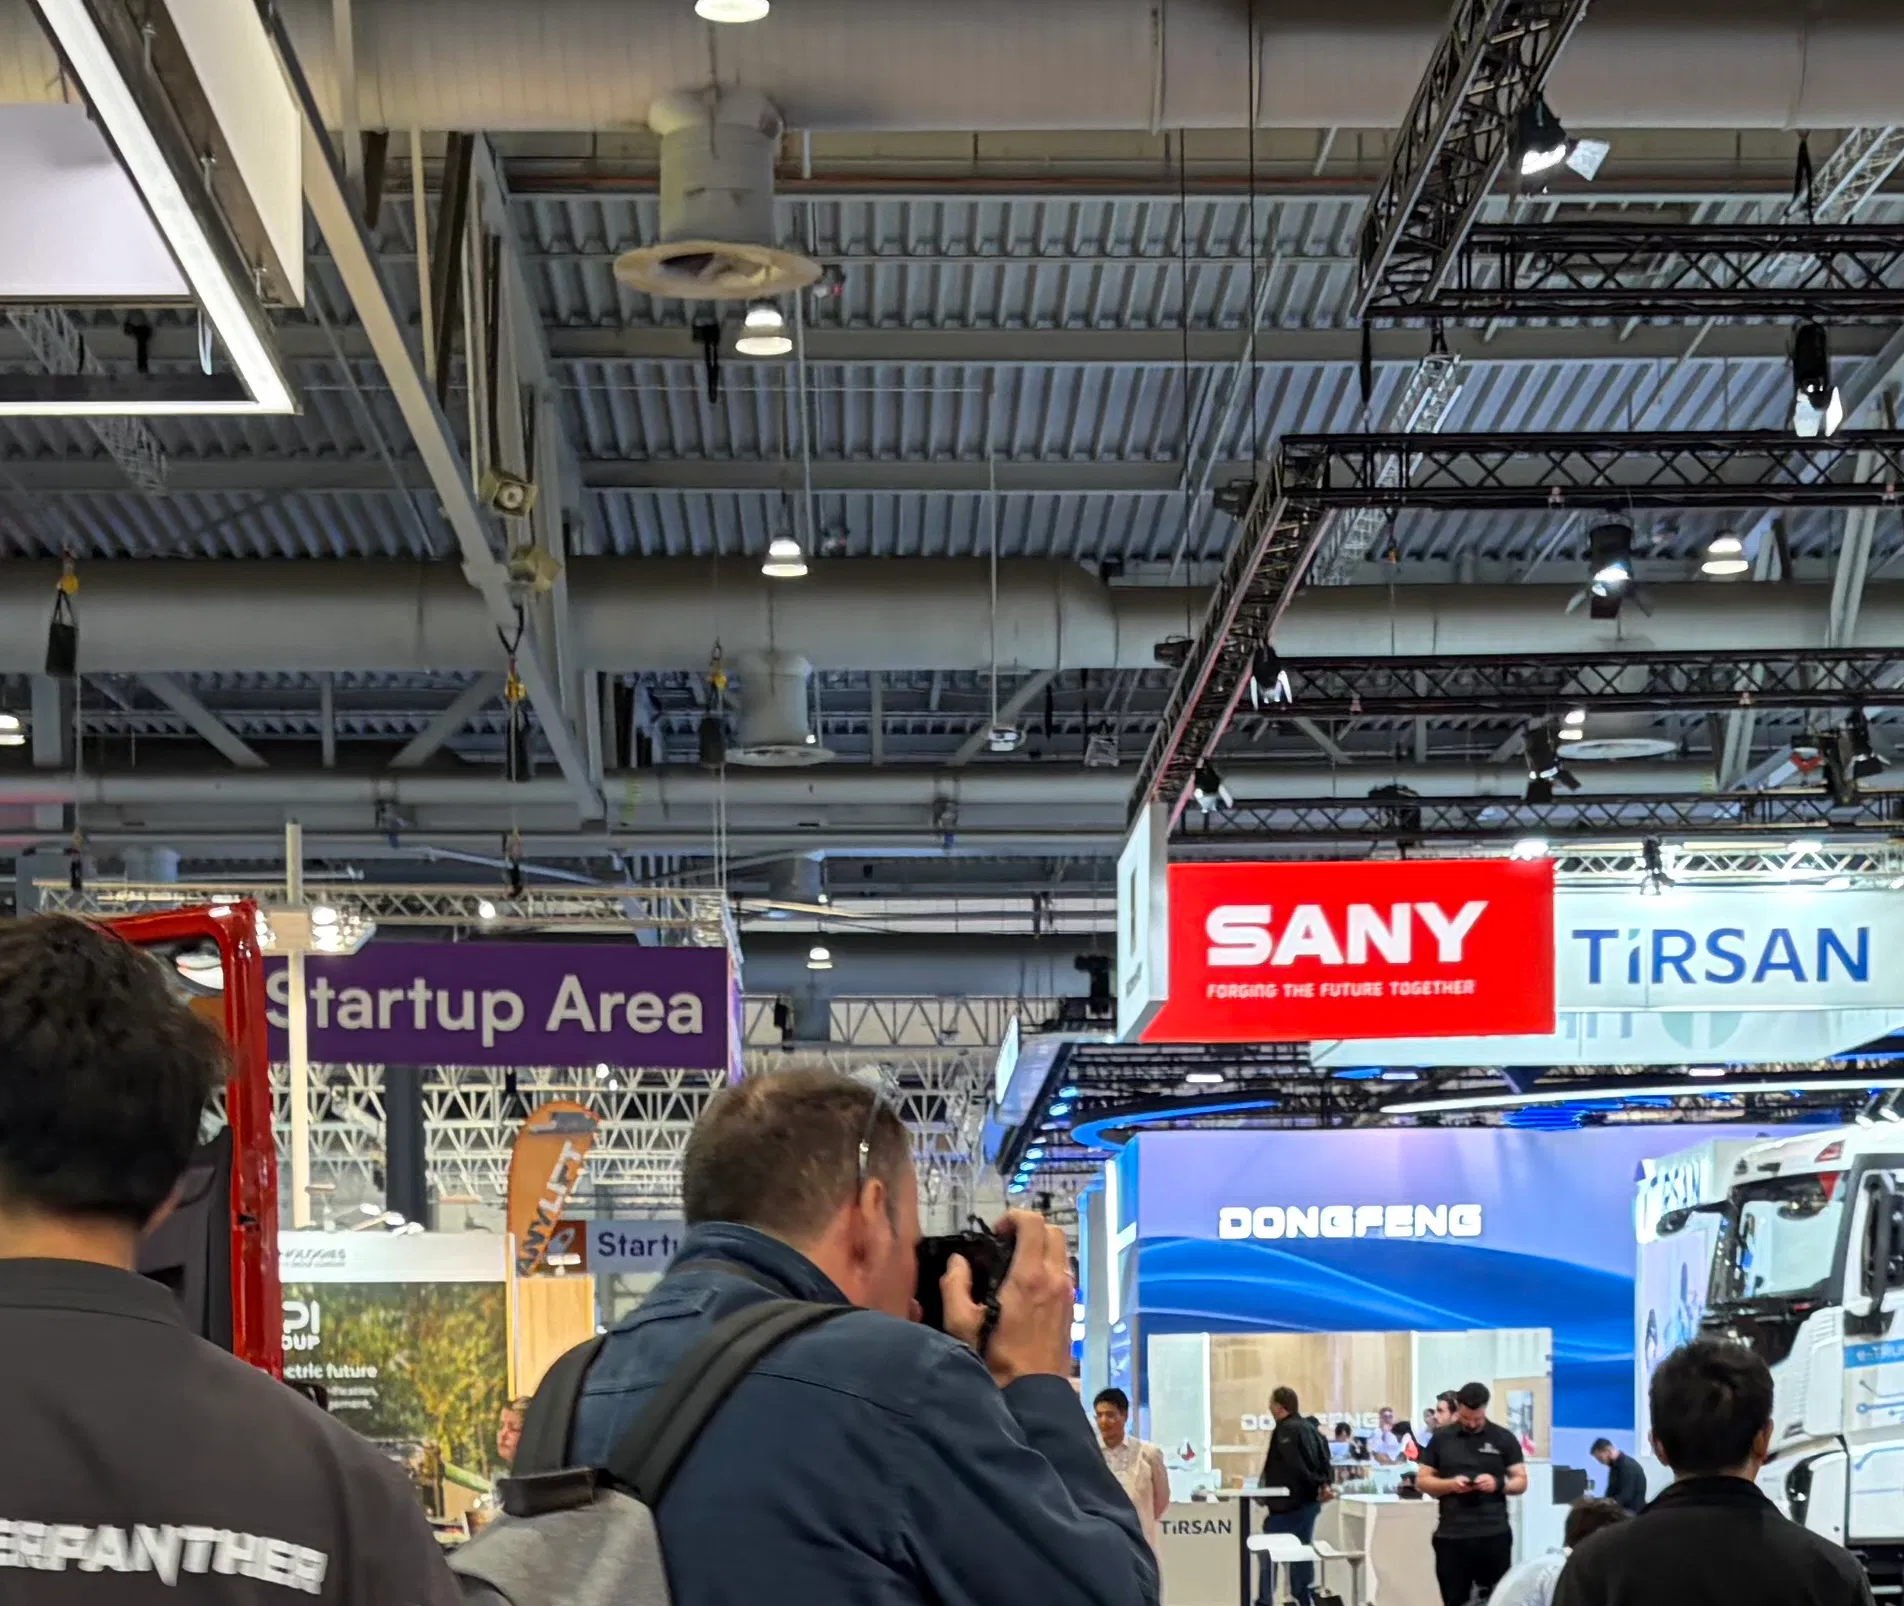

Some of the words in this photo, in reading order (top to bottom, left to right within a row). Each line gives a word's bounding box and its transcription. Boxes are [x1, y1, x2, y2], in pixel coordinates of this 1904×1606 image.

[1205, 900, 1490, 967] SANY
[266, 969, 525, 1047] Startup
[545, 973, 704, 1034] Area
[1283, 982, 1315, 998] THE
[1318, 981, 1383, 998] FUTURE
[1390, 978, 1476, 997] TOGETHER
[1219, 1204, 1483, 1240] DONGFENG
